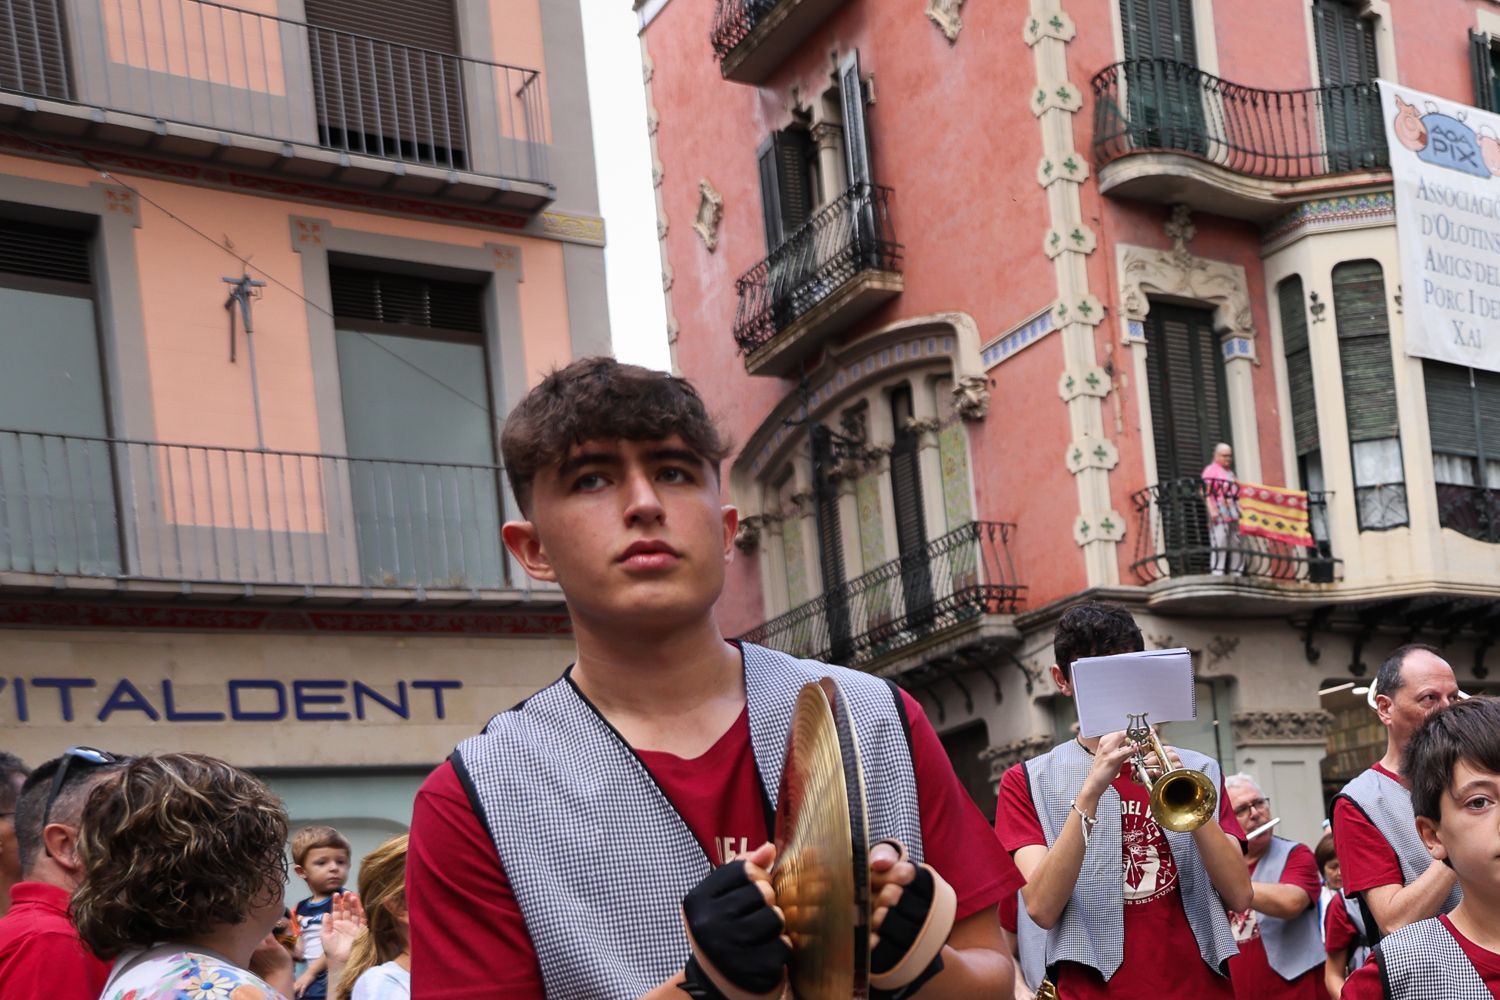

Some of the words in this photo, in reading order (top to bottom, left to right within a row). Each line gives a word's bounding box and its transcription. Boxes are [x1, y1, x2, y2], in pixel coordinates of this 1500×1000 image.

[1431, 137, 1479, 168] PIX
[1424, 245, 1472, 281] AMICS
[1423, 278, 1466, 313] PORC
[1468, 289, 1475, 315] I
[1452, 319, 1482, 350] XAI
[0, 677, 463, 723] ITALDENT
